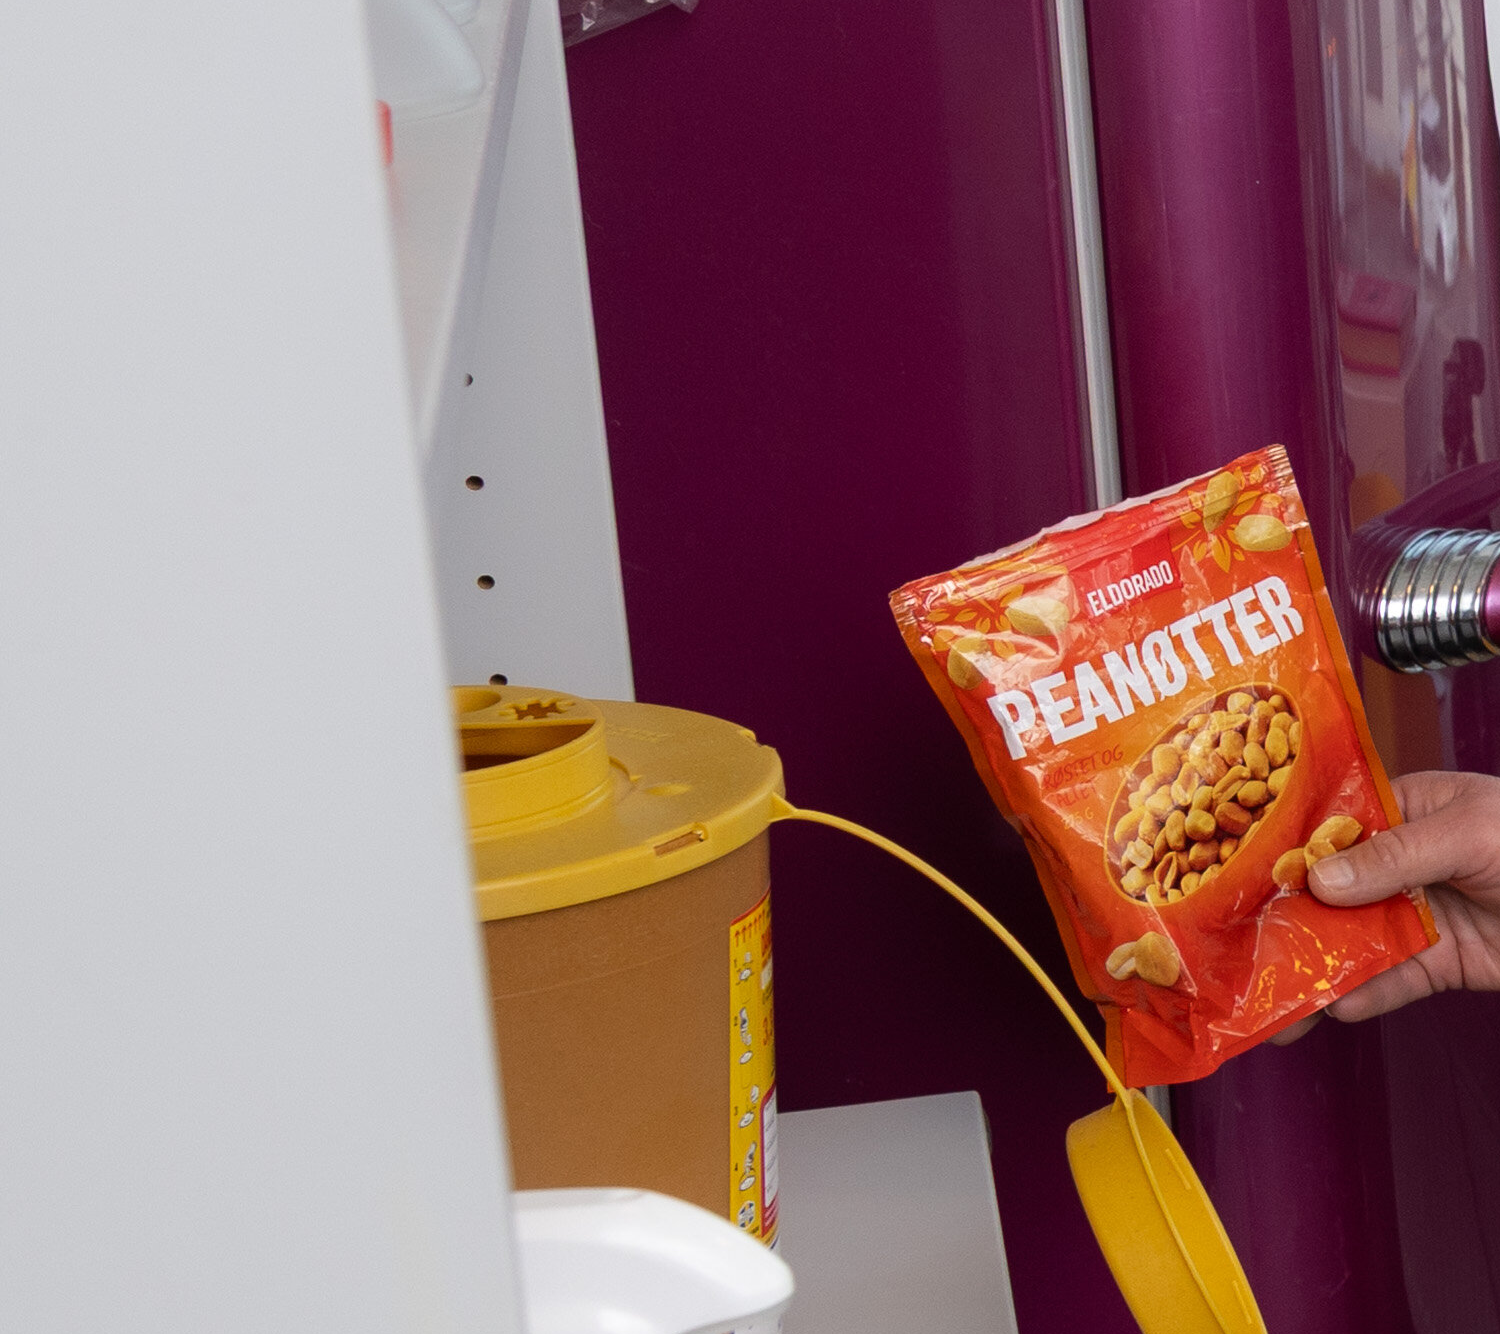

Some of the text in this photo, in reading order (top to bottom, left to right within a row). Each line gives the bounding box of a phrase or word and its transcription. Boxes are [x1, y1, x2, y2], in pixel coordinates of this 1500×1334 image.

[1086, 559, 1174, 617] ELDORADO
[986, 575, 1305, 761] PEANØTTER
[1043, 744, 1123, 790] RØSTET OG
[1050, 782, 1097, 812] ALTET
